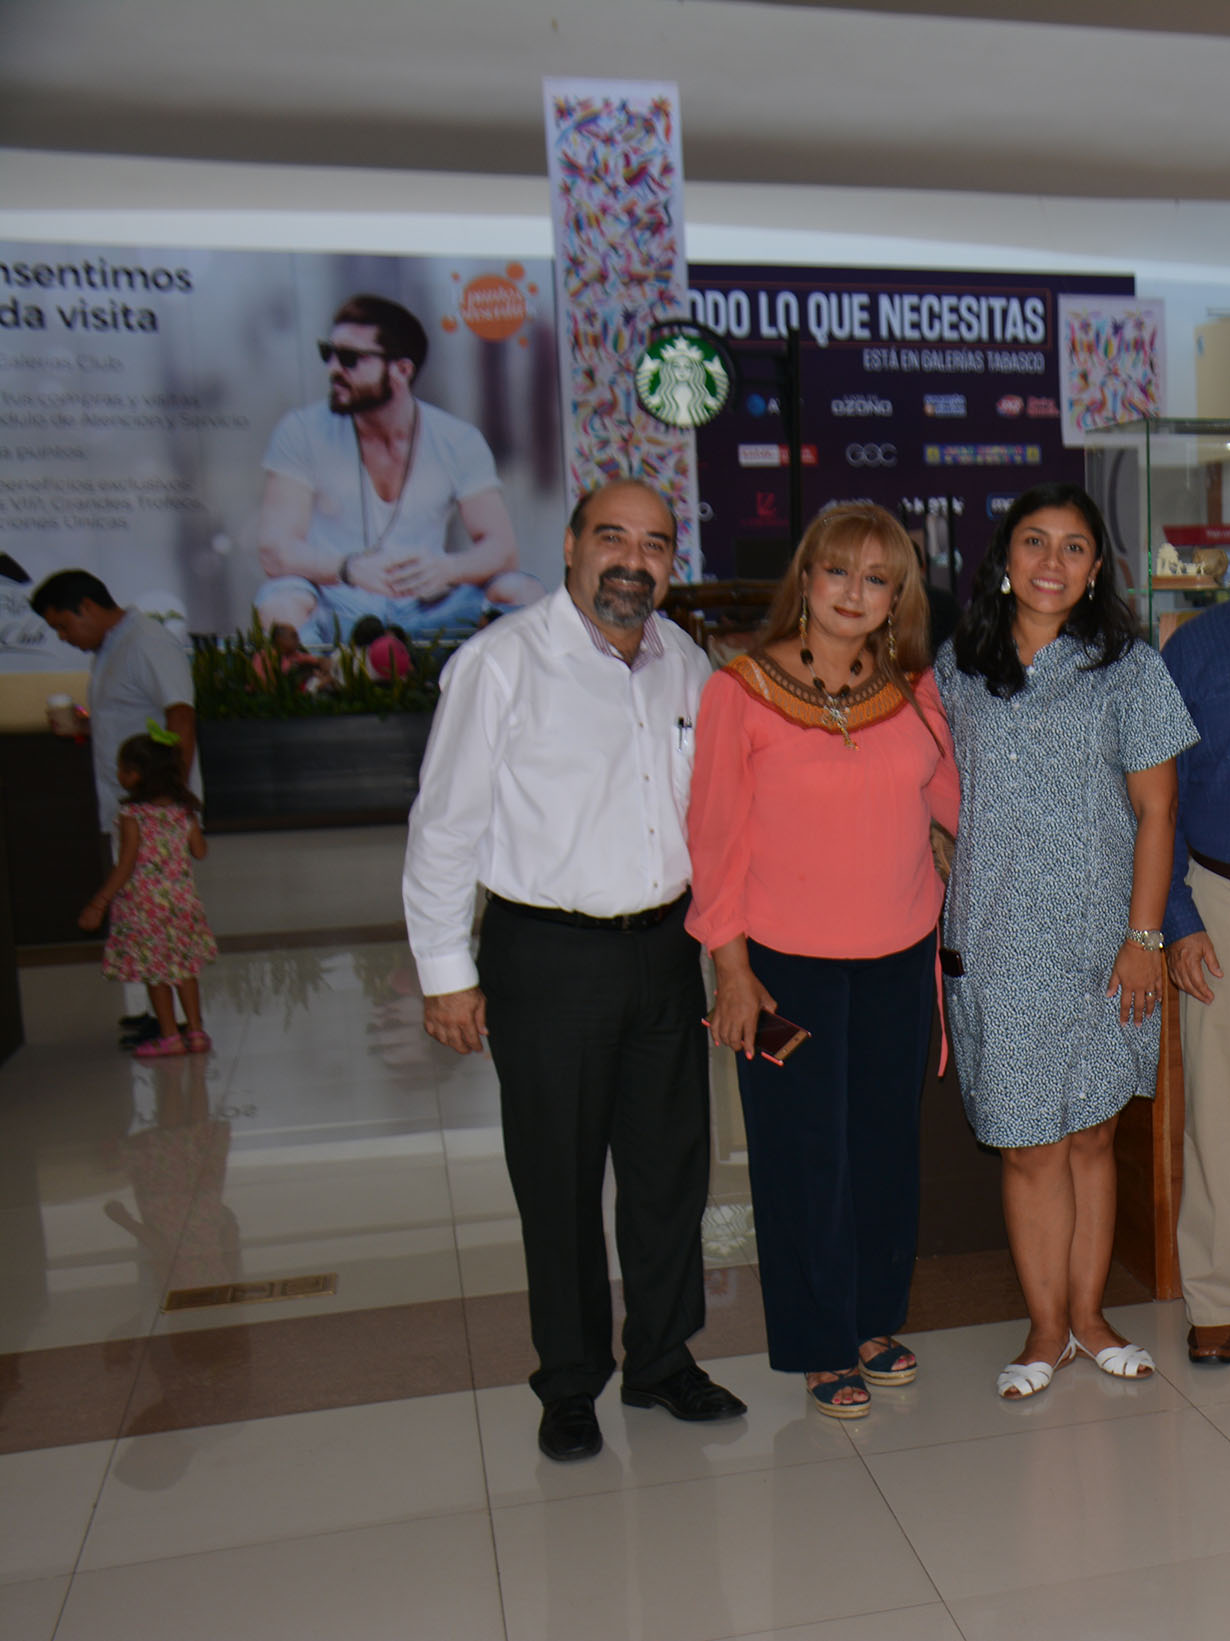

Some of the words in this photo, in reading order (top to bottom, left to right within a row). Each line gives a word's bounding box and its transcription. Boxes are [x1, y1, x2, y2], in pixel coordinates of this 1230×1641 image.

[0, 295, 46, 330] da
[57, 298, 159, 333] visita
[758, 290, 800, 340] LO
[807, 291, 872, 348] QUE
[878, 294, 1047, 344] NECESITAS
[863, 345, 900, 373] ESTÁ
[900, 349, 921, 374] EN
[921, 346, 985, 375] GALERÍAS
[987, 350, 1047, 376] TABASCO
[831, 399, 894, 417] OZONO
